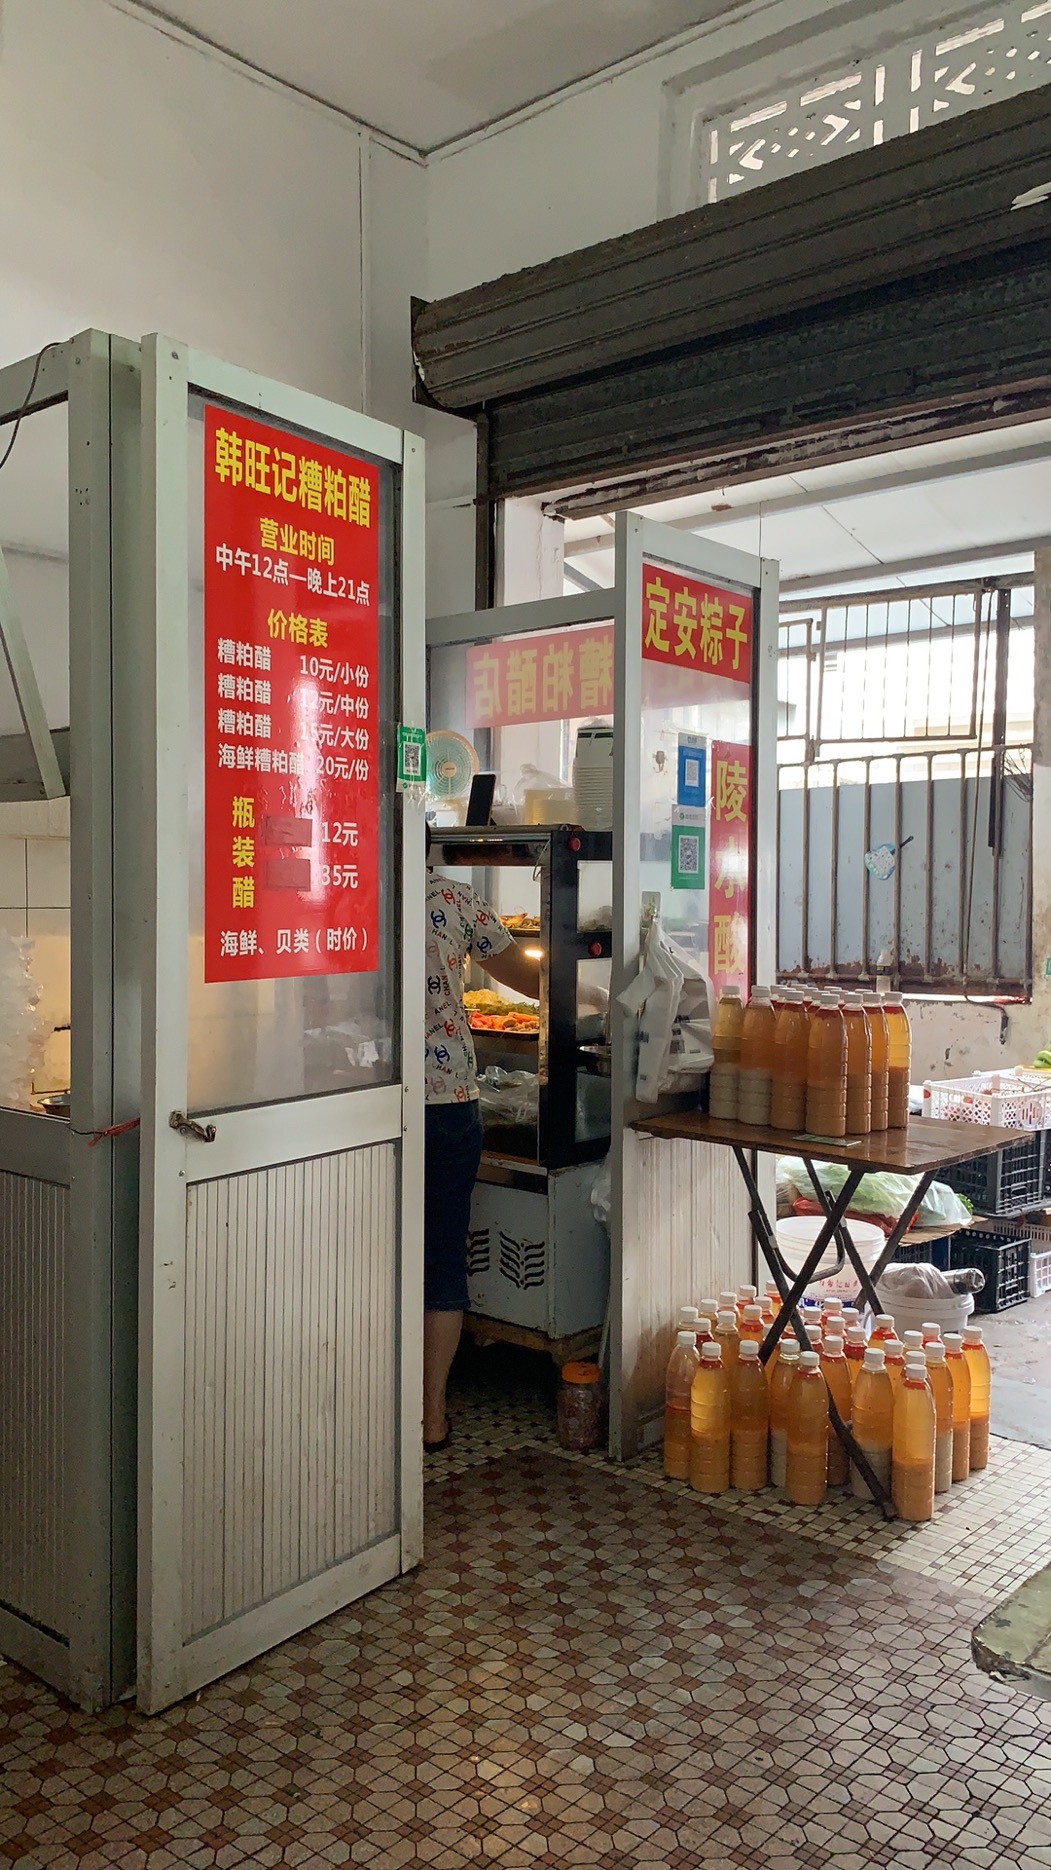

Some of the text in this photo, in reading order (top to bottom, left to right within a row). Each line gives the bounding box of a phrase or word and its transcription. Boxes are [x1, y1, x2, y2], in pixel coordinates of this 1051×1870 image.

[215, 427, 370, 528] 韩旺记糟粕醋
[259, 517, 335, 566] 营业时间
[267, 608, 328, 648] 价格表
[644, 576, 748, 670] 定安粽子
[217, 637, 369, 688] 糟粕醋 10元/小份
[217, 672, 271, 705] 糟粕醋
[217, 708, 369, 750] 糟粕醋 15元/大份
[218, 743, 369, 781] 海鲜糟粕醋 20元/份
[232, 796, 359, 908] 瓶装醋 12元
[321, 864, 359, 889] 35元
[713, 761, 748, 1003] 陵水酸
